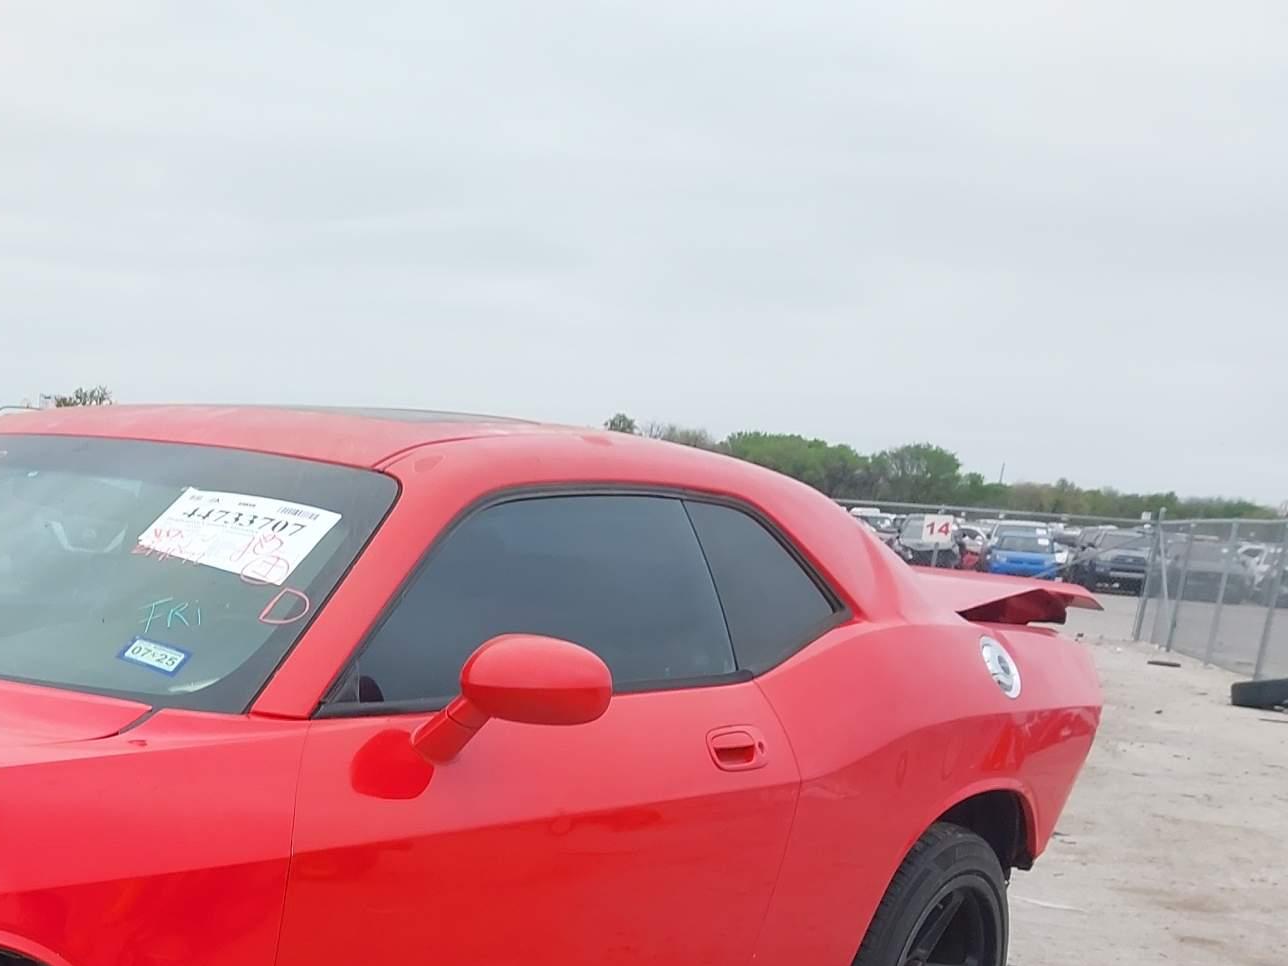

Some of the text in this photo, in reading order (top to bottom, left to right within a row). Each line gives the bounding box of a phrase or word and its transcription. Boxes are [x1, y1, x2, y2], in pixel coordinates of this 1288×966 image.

[182, 507, 306, 536] 44733707
[925, 521, 951, 537] 14
[131, 645, 178, 667] 07 25
